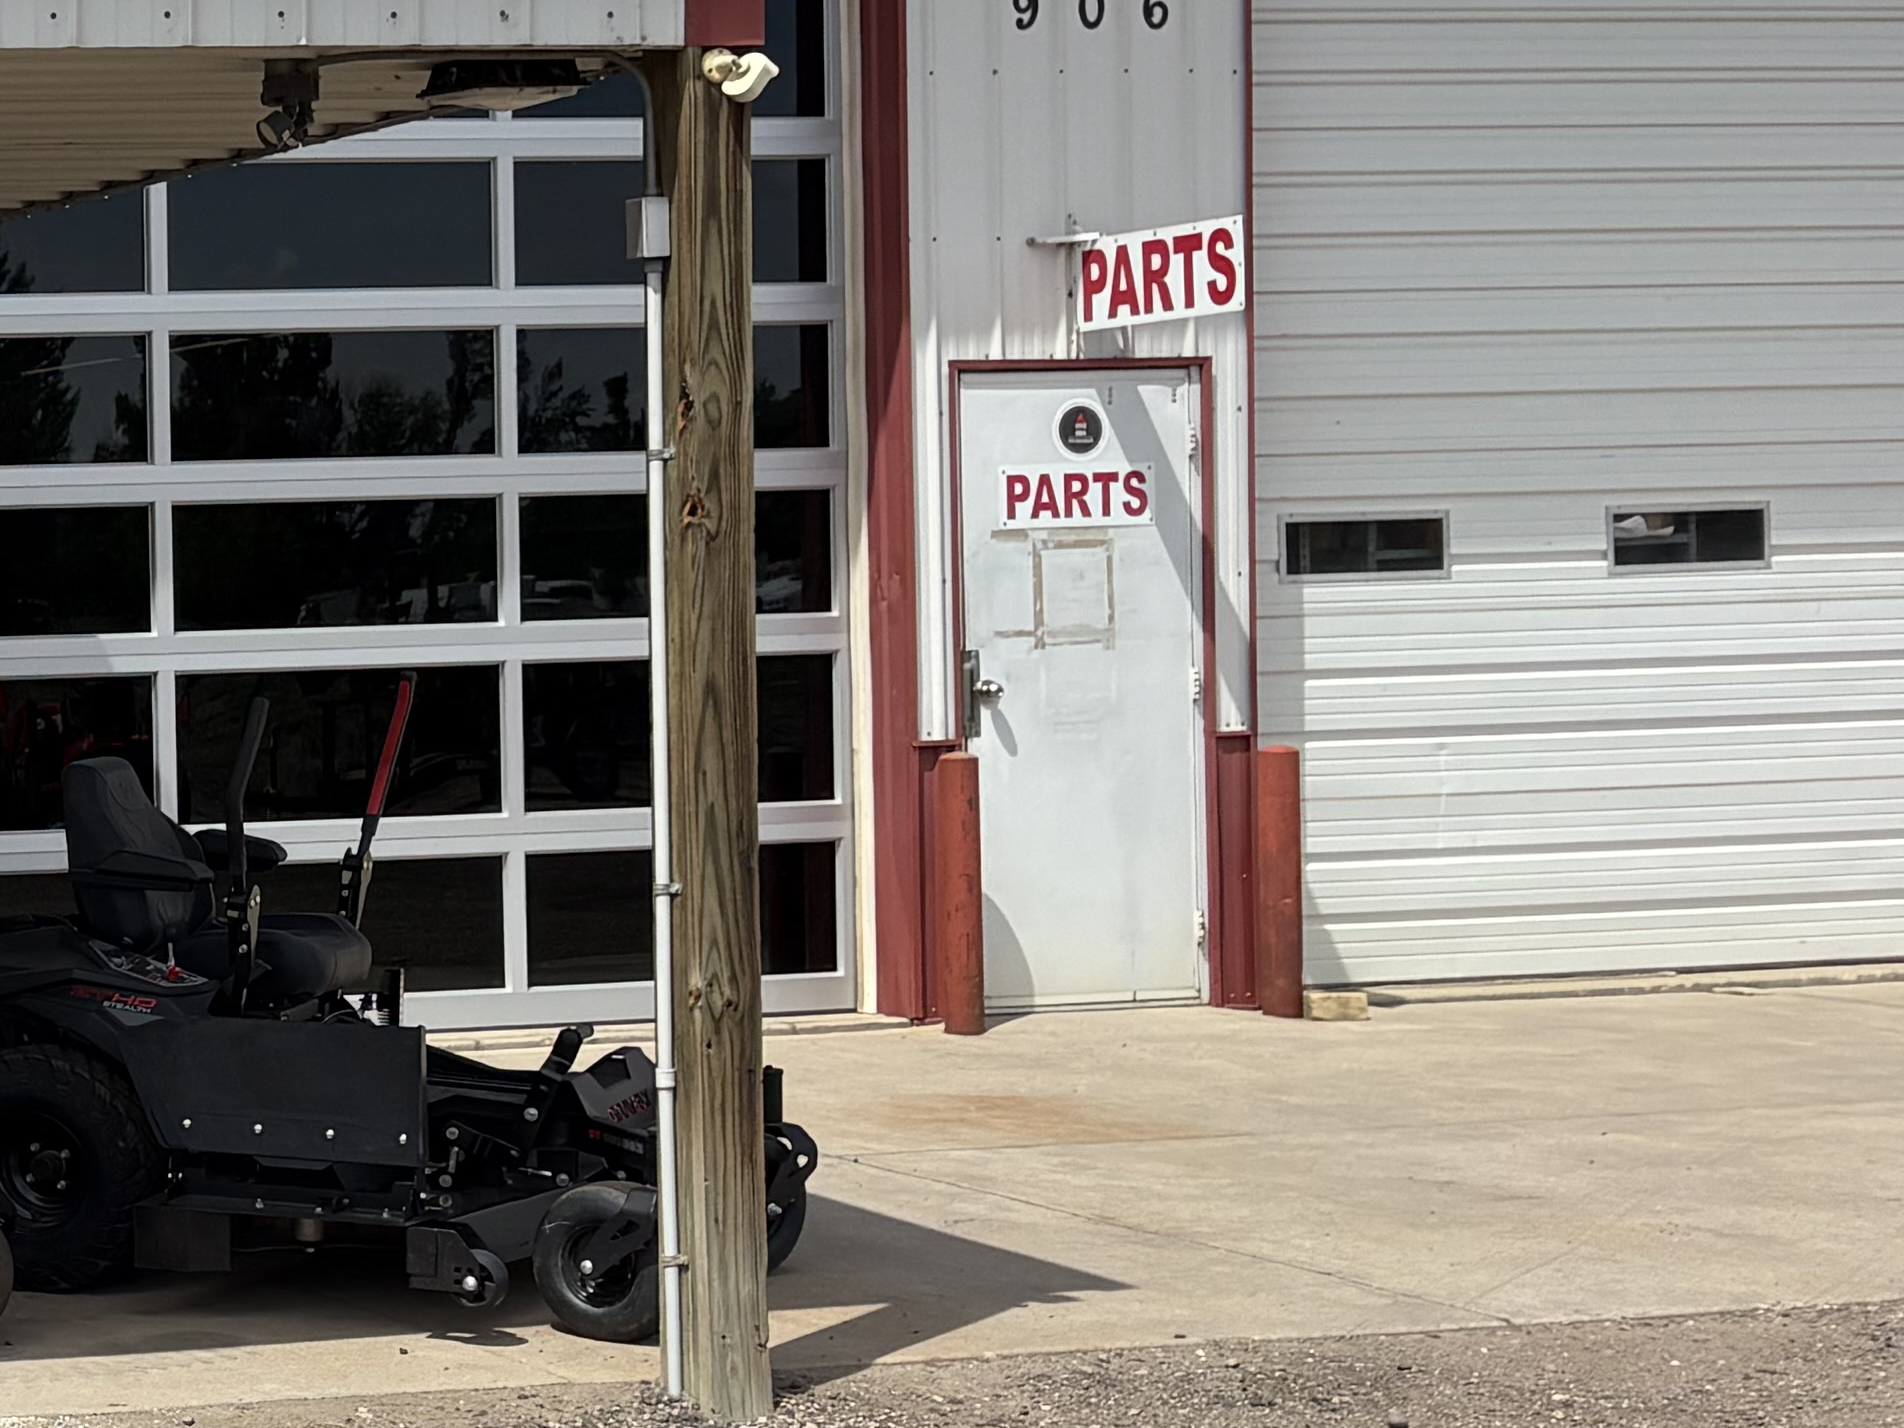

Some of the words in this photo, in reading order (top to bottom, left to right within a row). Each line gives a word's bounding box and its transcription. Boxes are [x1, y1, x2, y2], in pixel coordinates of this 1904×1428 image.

[1081, 227, 1237, 323] PARTS
[1005, 470, 1149, 521] PARTS
[102, 1000, 152, 1013] STEALTH
